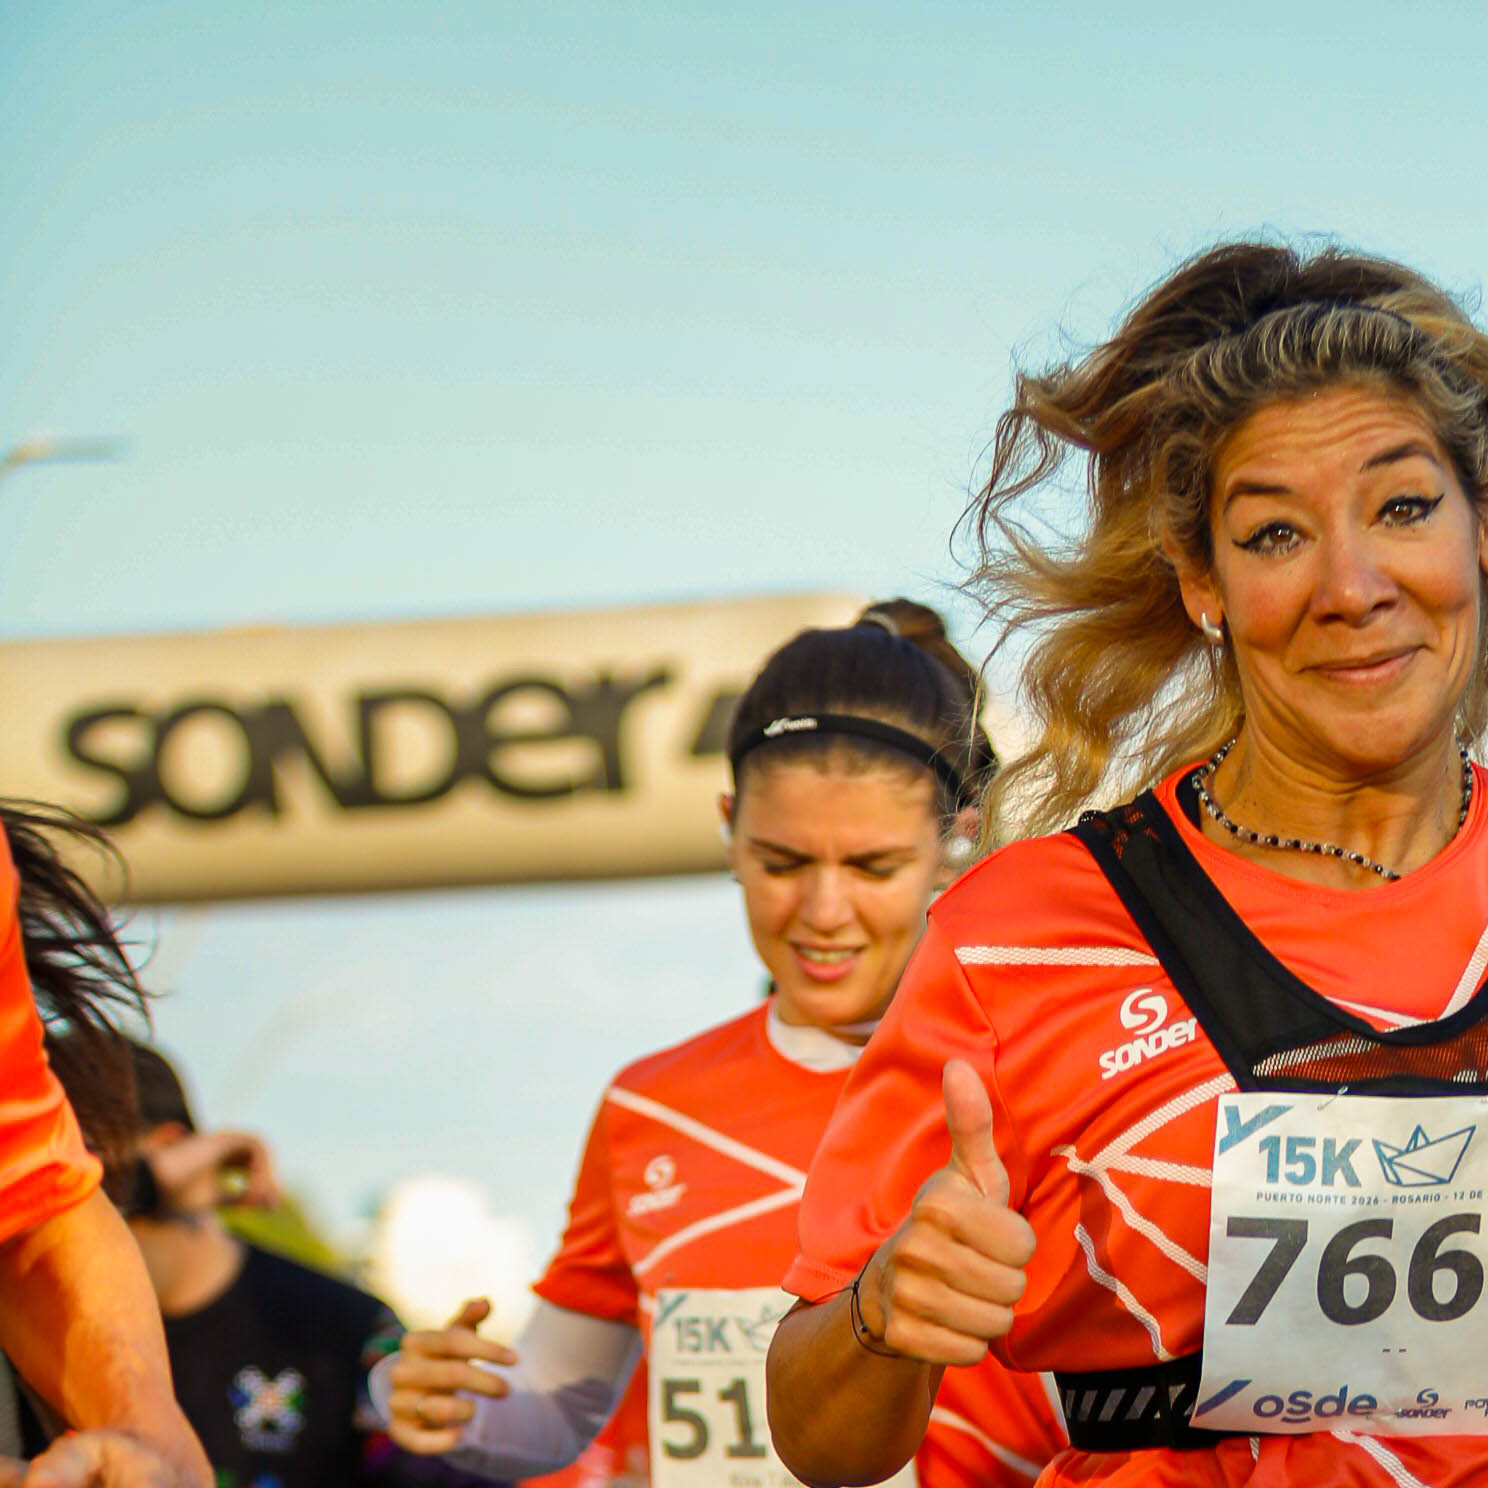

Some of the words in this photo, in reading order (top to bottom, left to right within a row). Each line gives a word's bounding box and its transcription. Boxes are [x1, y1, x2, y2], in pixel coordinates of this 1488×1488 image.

[1258, 1135, 1363, 1188] 15K
[1256, 1191, 1303, 1202] PUERTO
[1307, 1193, 1346, 1205] NORTE
[1351, 1195, 1379, 1206] 2026
[1391, 1192, 1441, 1205] ROSARIO
[1453, 1190, 1465, 1201] 12
[1469, 1189, 1483, 1200] DE
[674, 1315, 732, 1354] 15K
[660, 1376, 768, 1461] 51
[1252, 1384, 1379, 1424] osde
